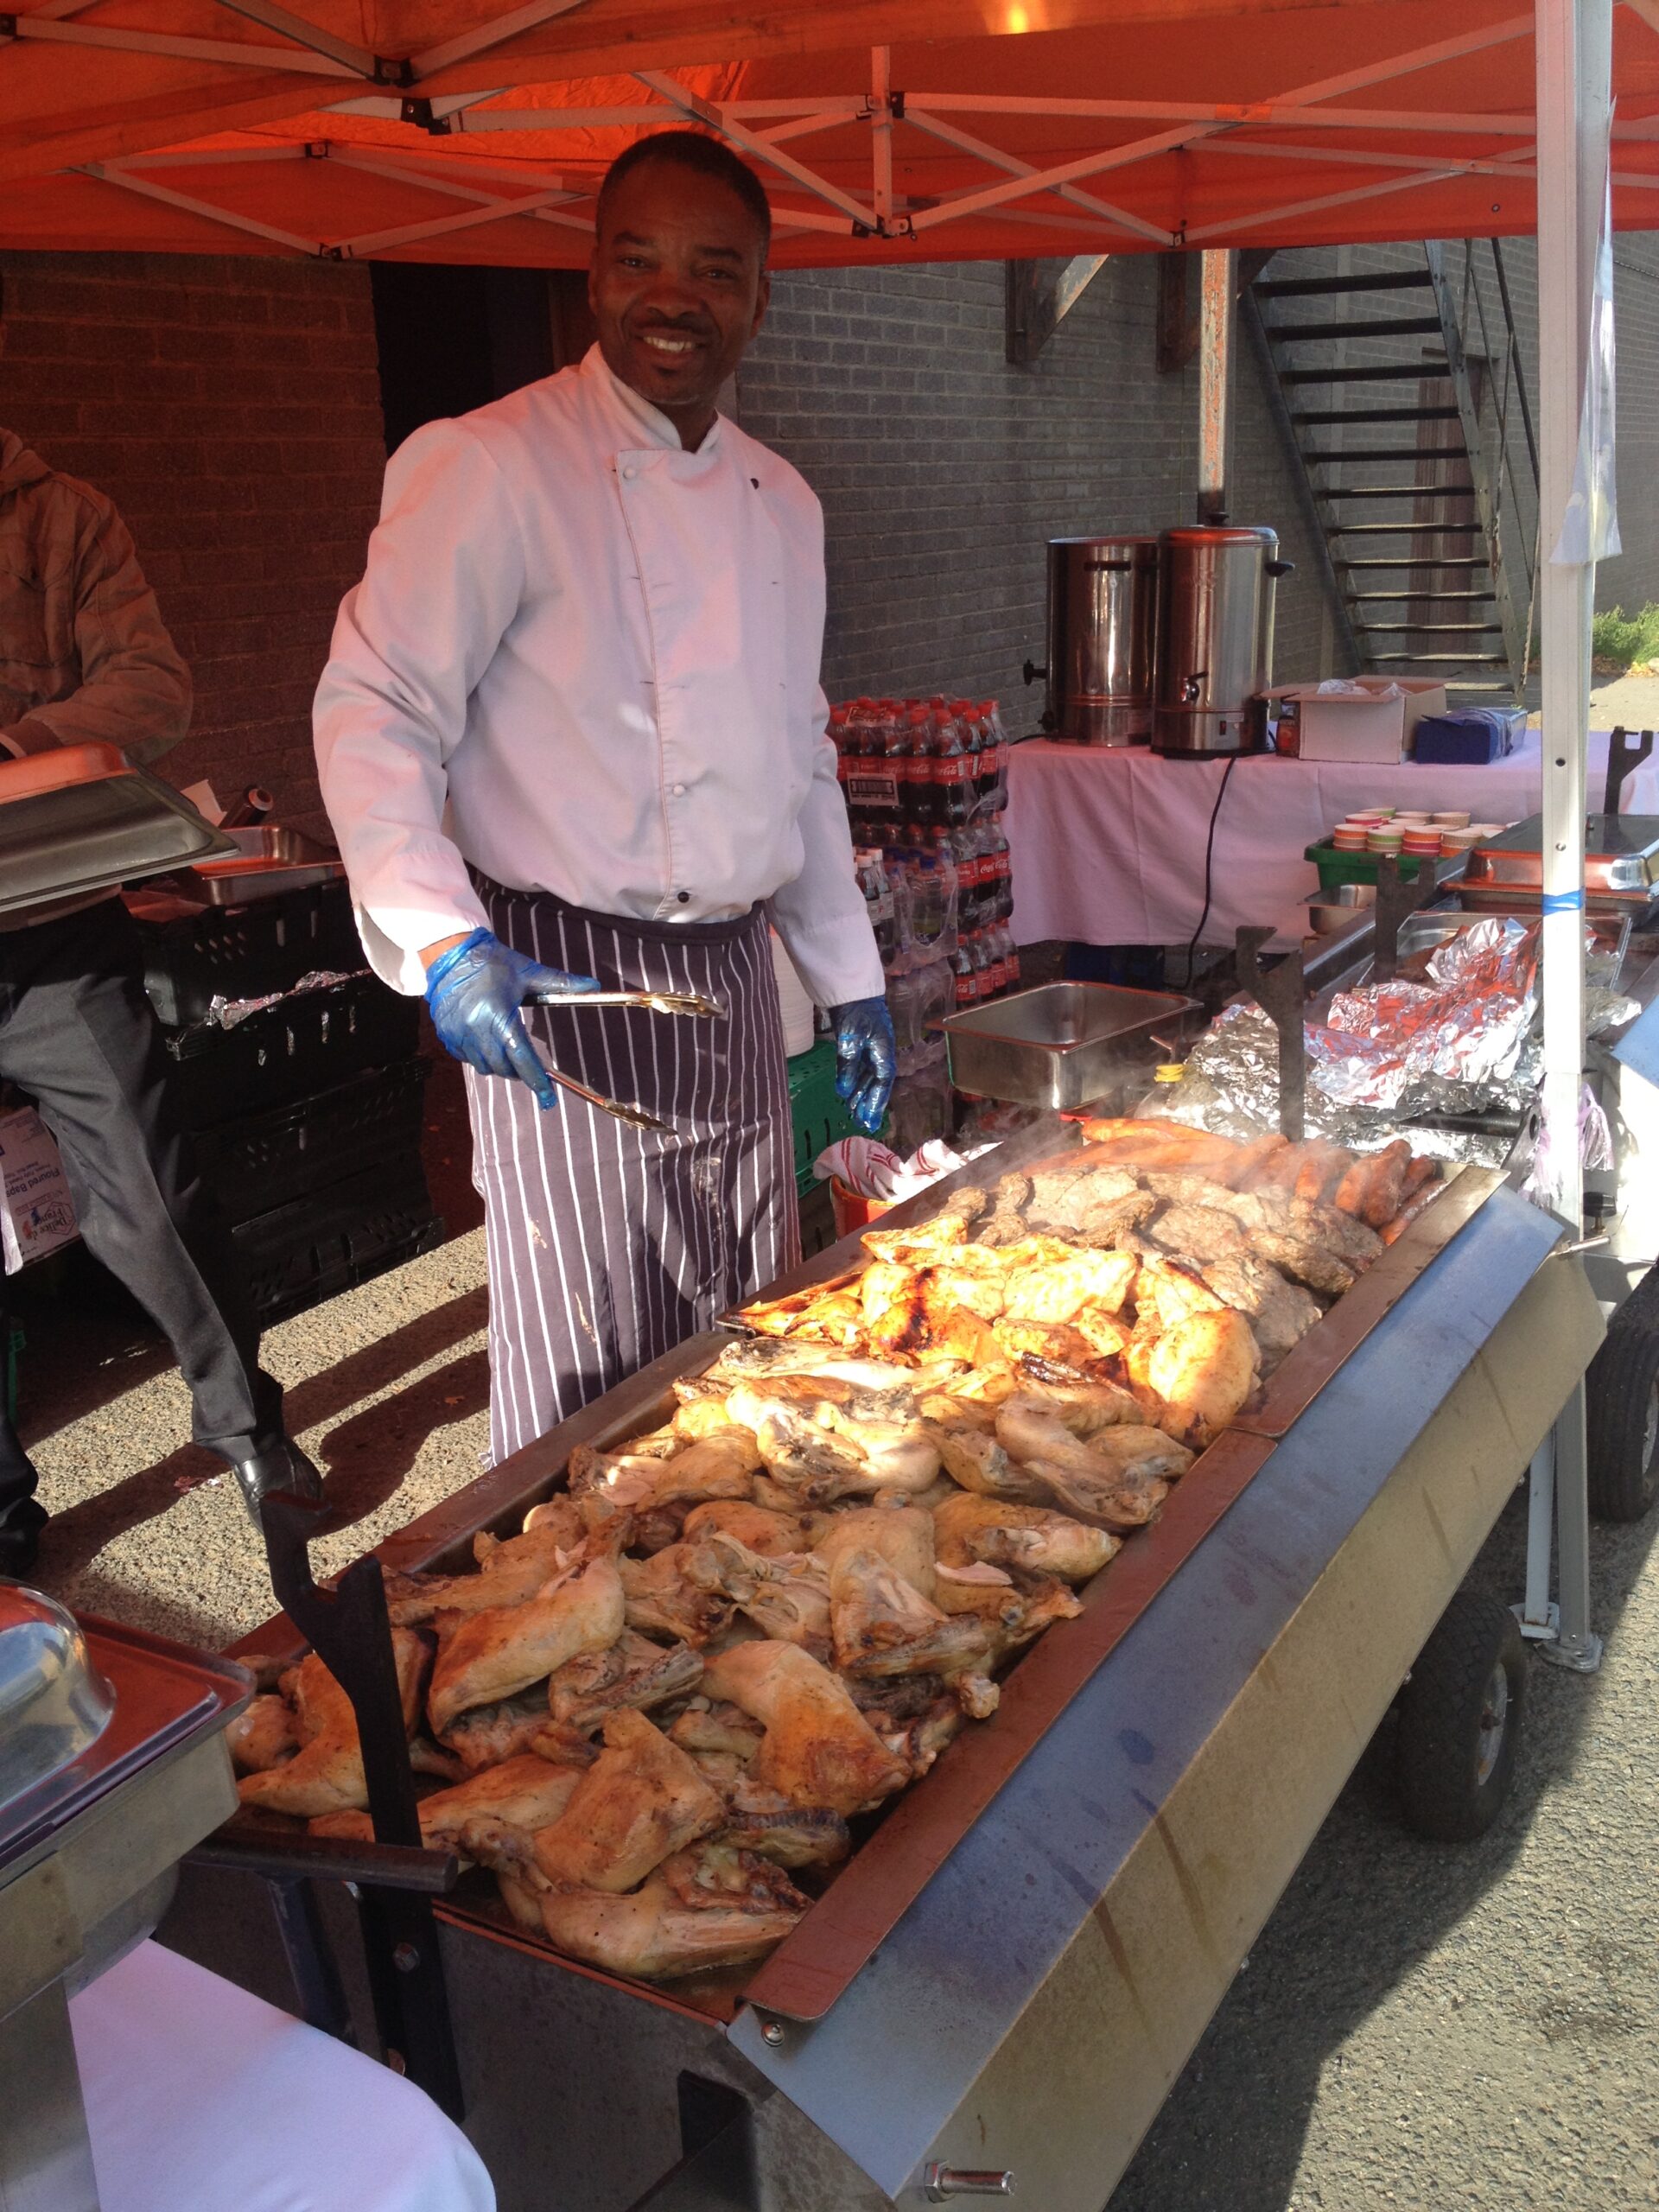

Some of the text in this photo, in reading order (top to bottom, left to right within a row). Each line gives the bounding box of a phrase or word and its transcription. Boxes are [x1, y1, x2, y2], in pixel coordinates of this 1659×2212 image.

[27, 1167, 60, 1189] Floured
[6, 1183, 28, 1198] Baps
[40, 1217, 67, 1234] Delice
